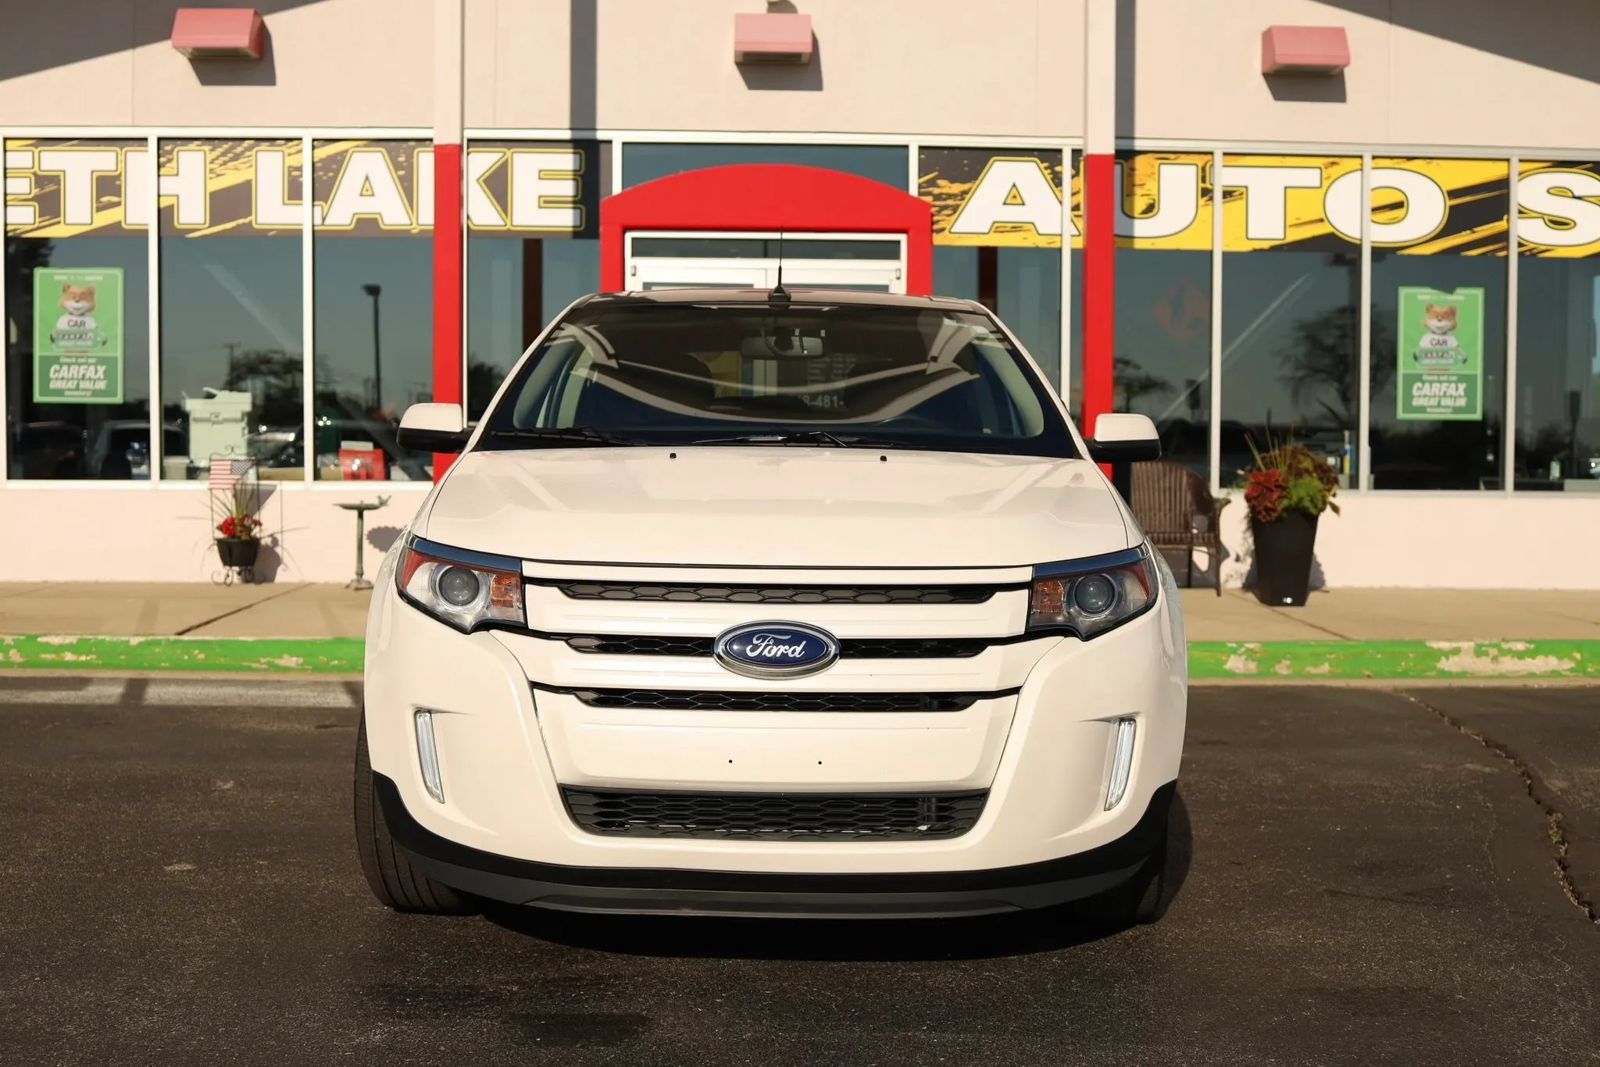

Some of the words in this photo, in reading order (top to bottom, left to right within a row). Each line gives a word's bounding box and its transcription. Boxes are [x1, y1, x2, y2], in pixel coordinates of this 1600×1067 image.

[253, 149, 584, 230] LAKE
[949, 158, 1447, 247] AUTO
[49, 364, 107, 379] CARFAX
[49, 379, 79, 389] GREAT
[1412, 382, 1467, 397] CARFAX
[745, 634, 807, 657] Ford
